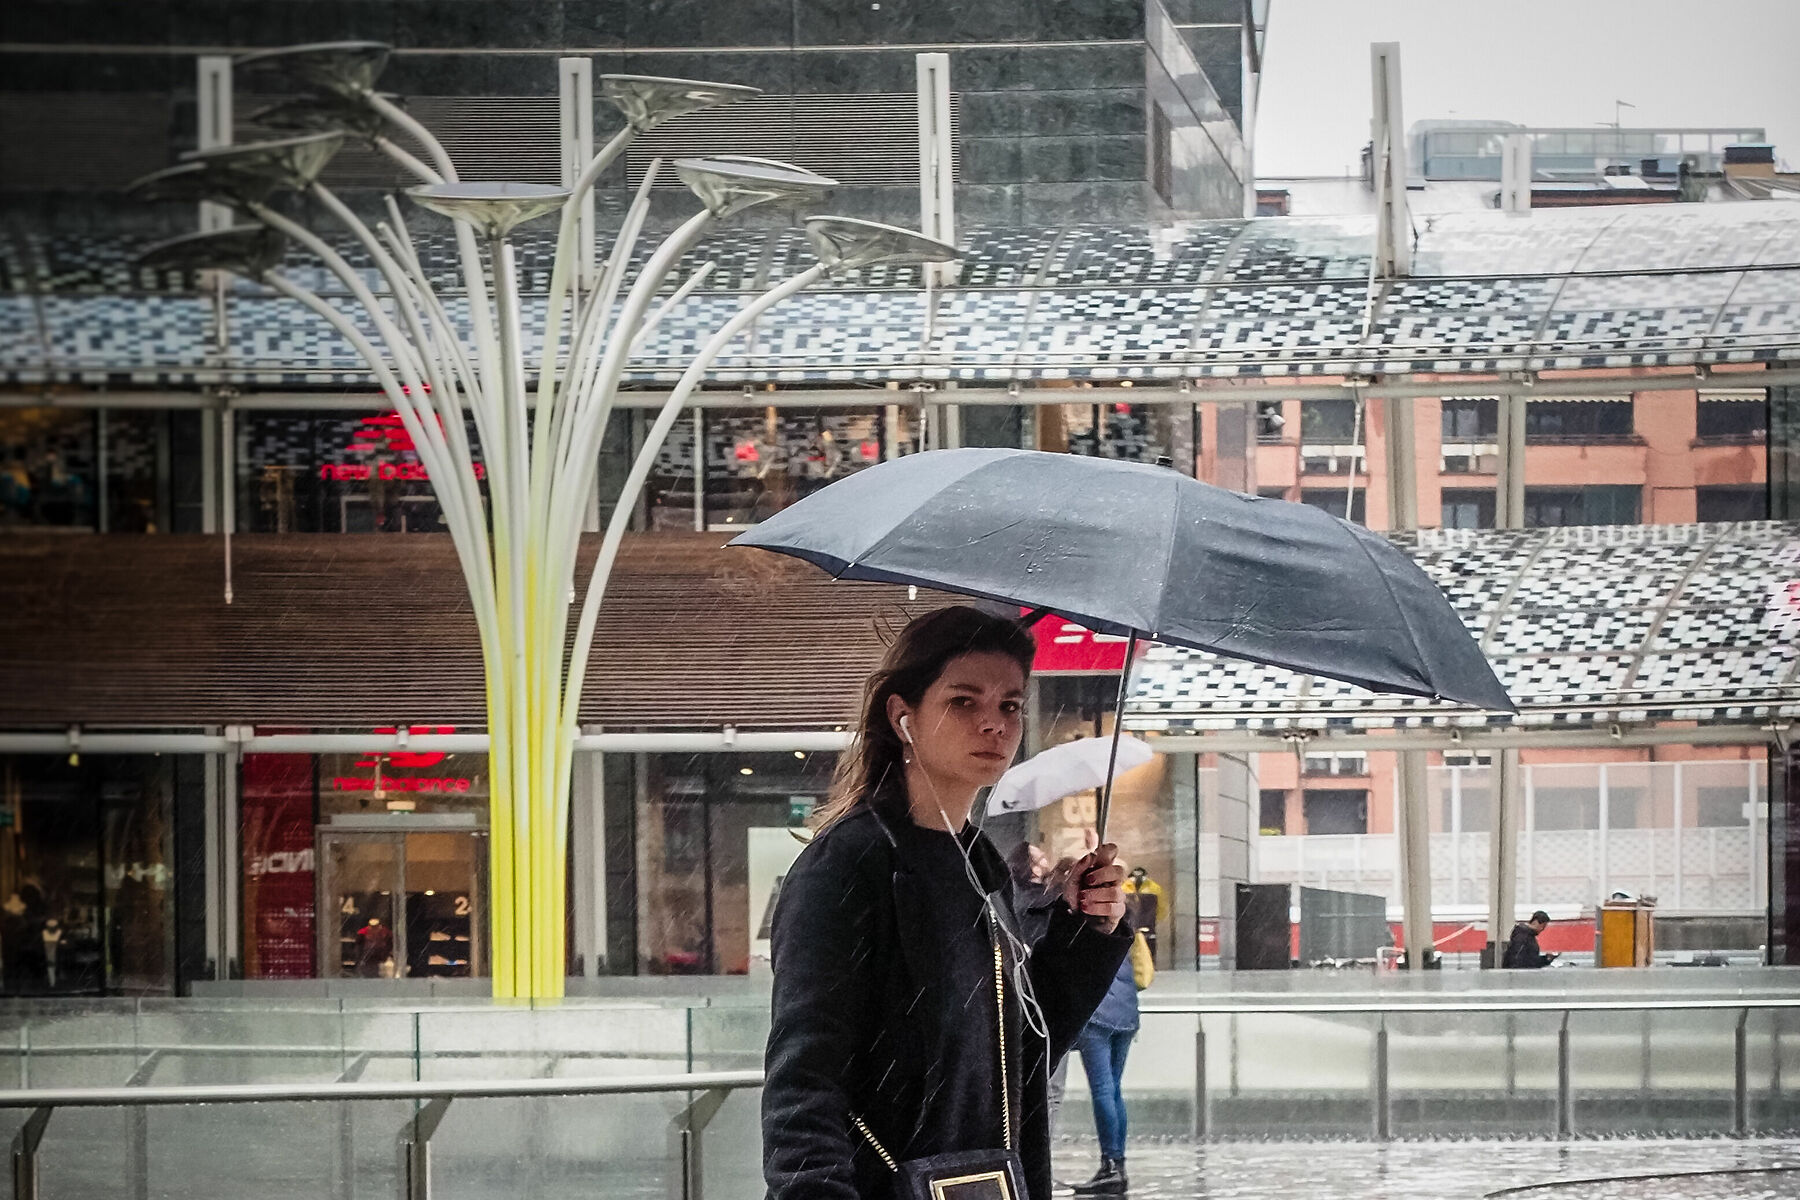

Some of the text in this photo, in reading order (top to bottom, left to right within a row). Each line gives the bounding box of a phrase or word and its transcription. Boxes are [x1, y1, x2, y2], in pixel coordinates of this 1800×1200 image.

[320, 463, 372, 480] new
[333, 774, 470, 792] new balance
